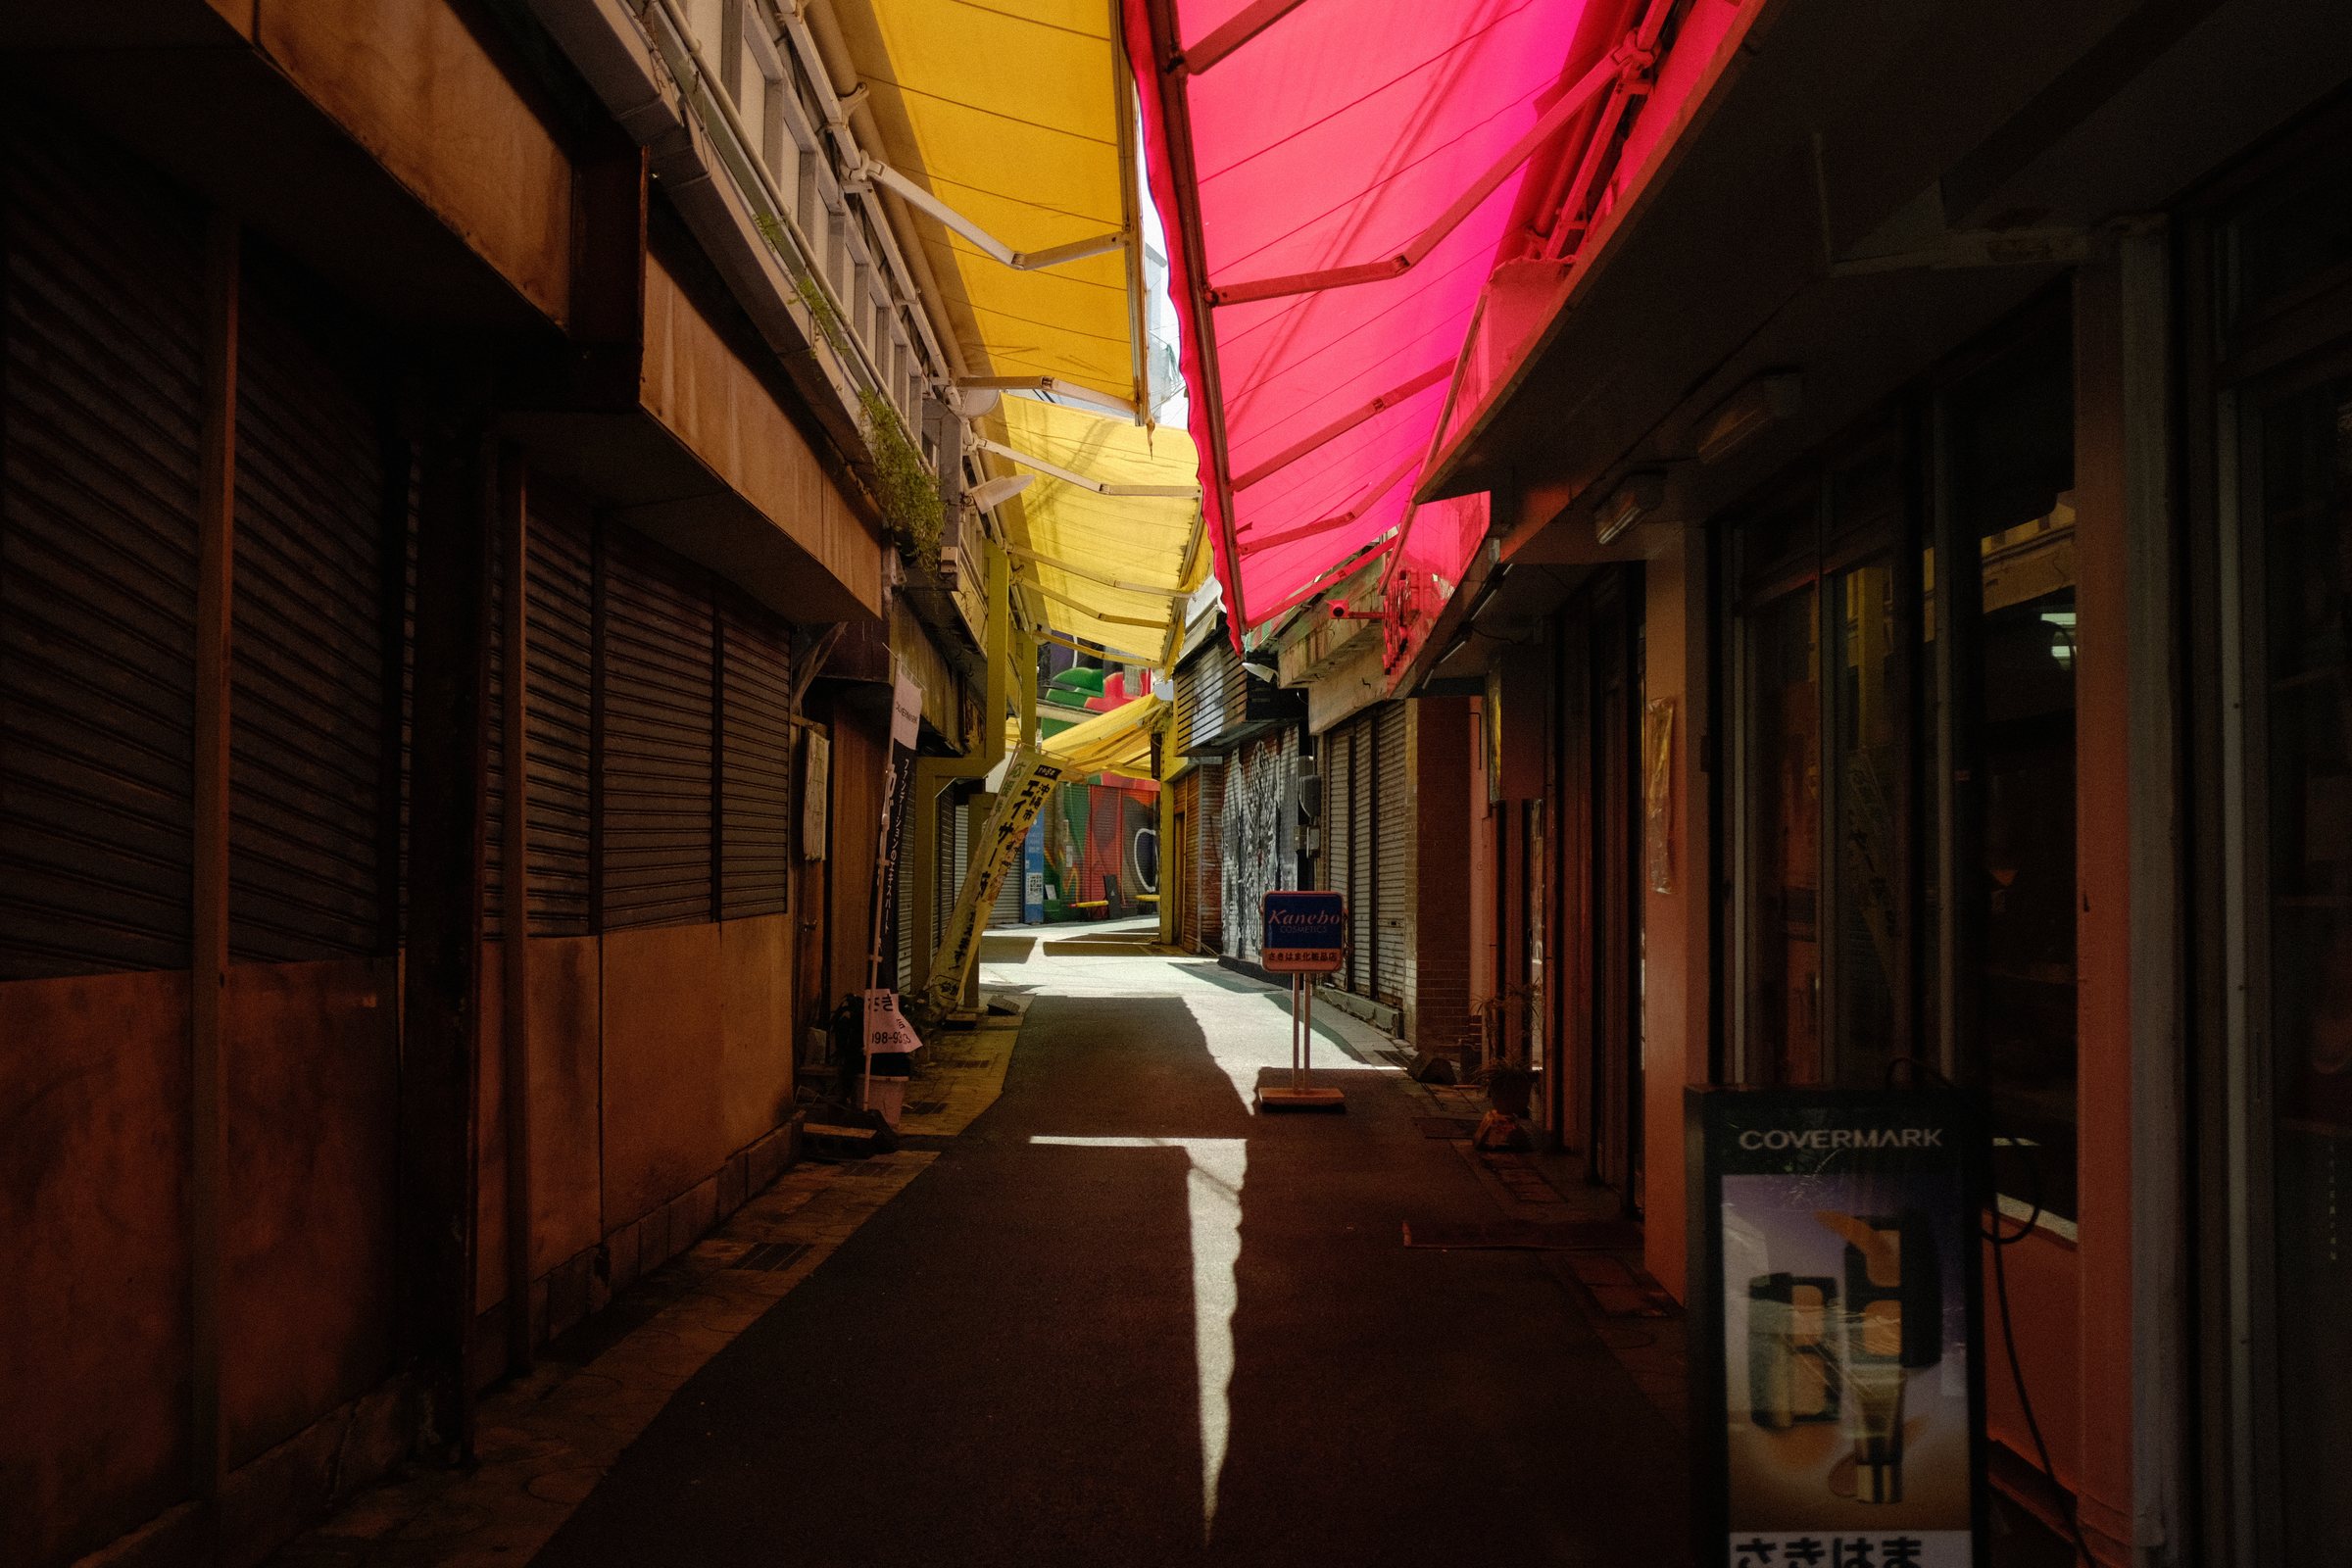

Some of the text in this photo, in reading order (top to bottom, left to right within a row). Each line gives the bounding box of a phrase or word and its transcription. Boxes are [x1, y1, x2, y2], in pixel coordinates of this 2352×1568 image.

[1268, 908, 1341, 925] Kanebo
[1268, 952, 1338, 962] さきはま化粧品店
[1739, 1128, 1943, 1151] COVERMARK
[1736, 1536, 1922, 1568] さきはま
